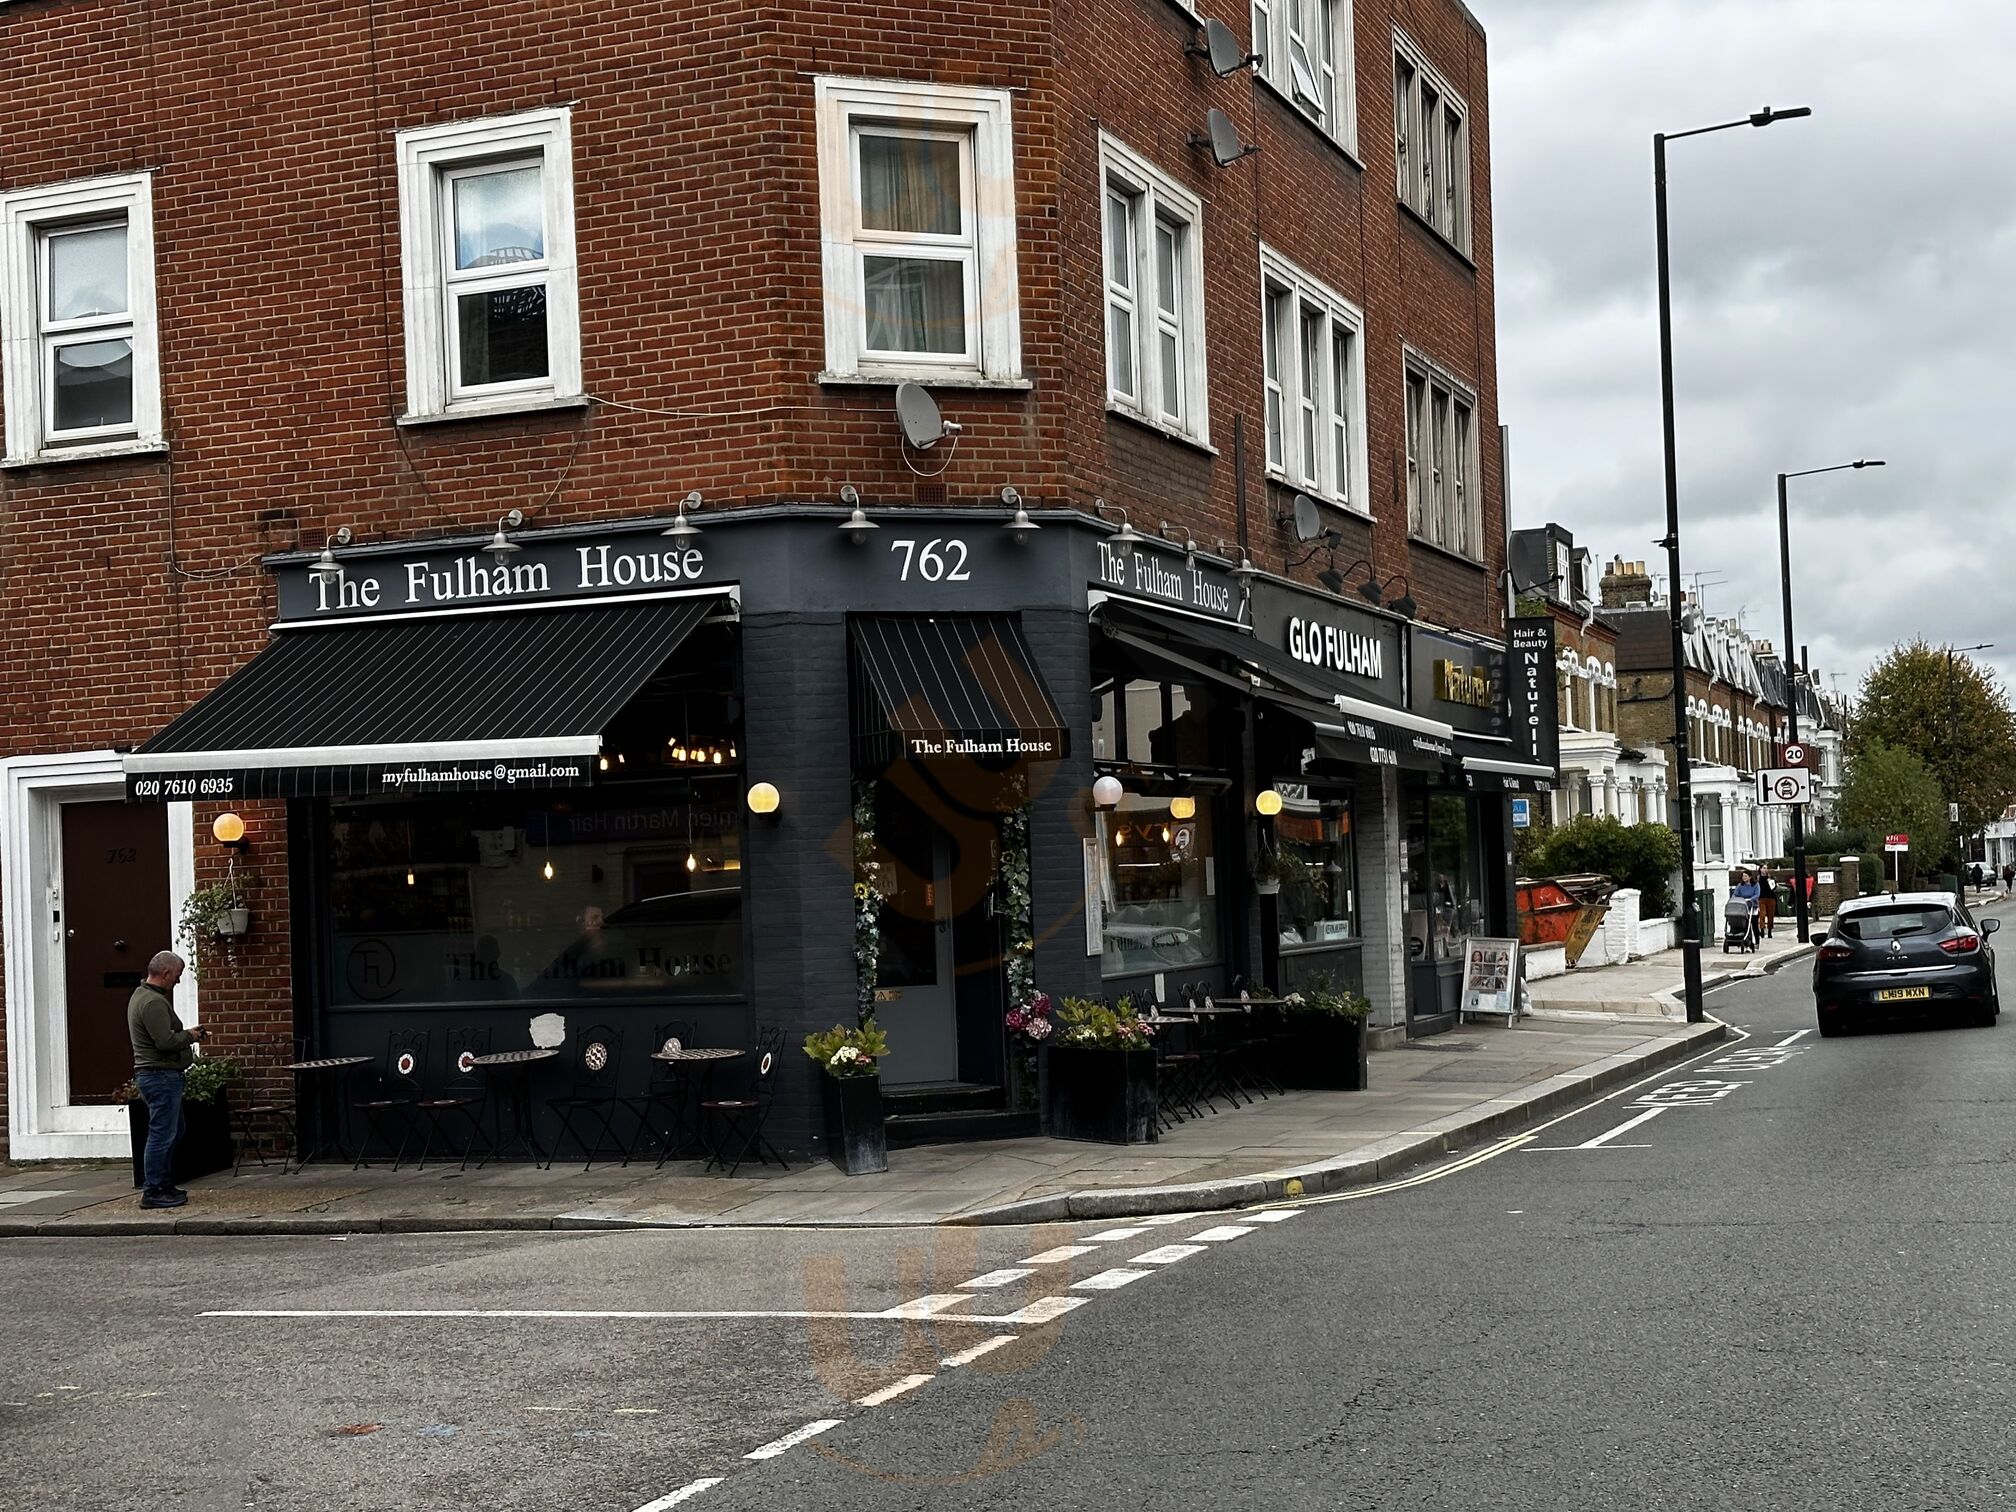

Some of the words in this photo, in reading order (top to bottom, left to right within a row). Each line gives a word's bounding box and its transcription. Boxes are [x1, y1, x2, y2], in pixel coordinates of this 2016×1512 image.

[890, 538, 971, 582] 762
[308, 566, 380, 611] The
[404, 555, 551, 604] Fulham
[576, 544, 704, 588] House
[1097, 541, 1126, 586] The
[1133, 551, 1183, 602] Fulham
[1192, 570, 1230, 614] House
[1513, 628, 1535, 638] Hair
[1537, 628, 1547, 637] &
[1513, 639, 1548, 649] Beauty
[1289, 616, 1322, 667] GLO
[1325, 626, 1382, 679] FULHAM
[911, 739, 942, 753] The
[945, 739, 1002, 754] Fulham
[1006, 738, 1052, 753] House
[1786, 750, 1803, 760] 20
[135, 779, 161, 797] 020
[164, 778, 196, 796] 7610
[200, 776, 234, 795] 6935
[382, 763, 580, 788] myfulhamhouse@gmail.com
